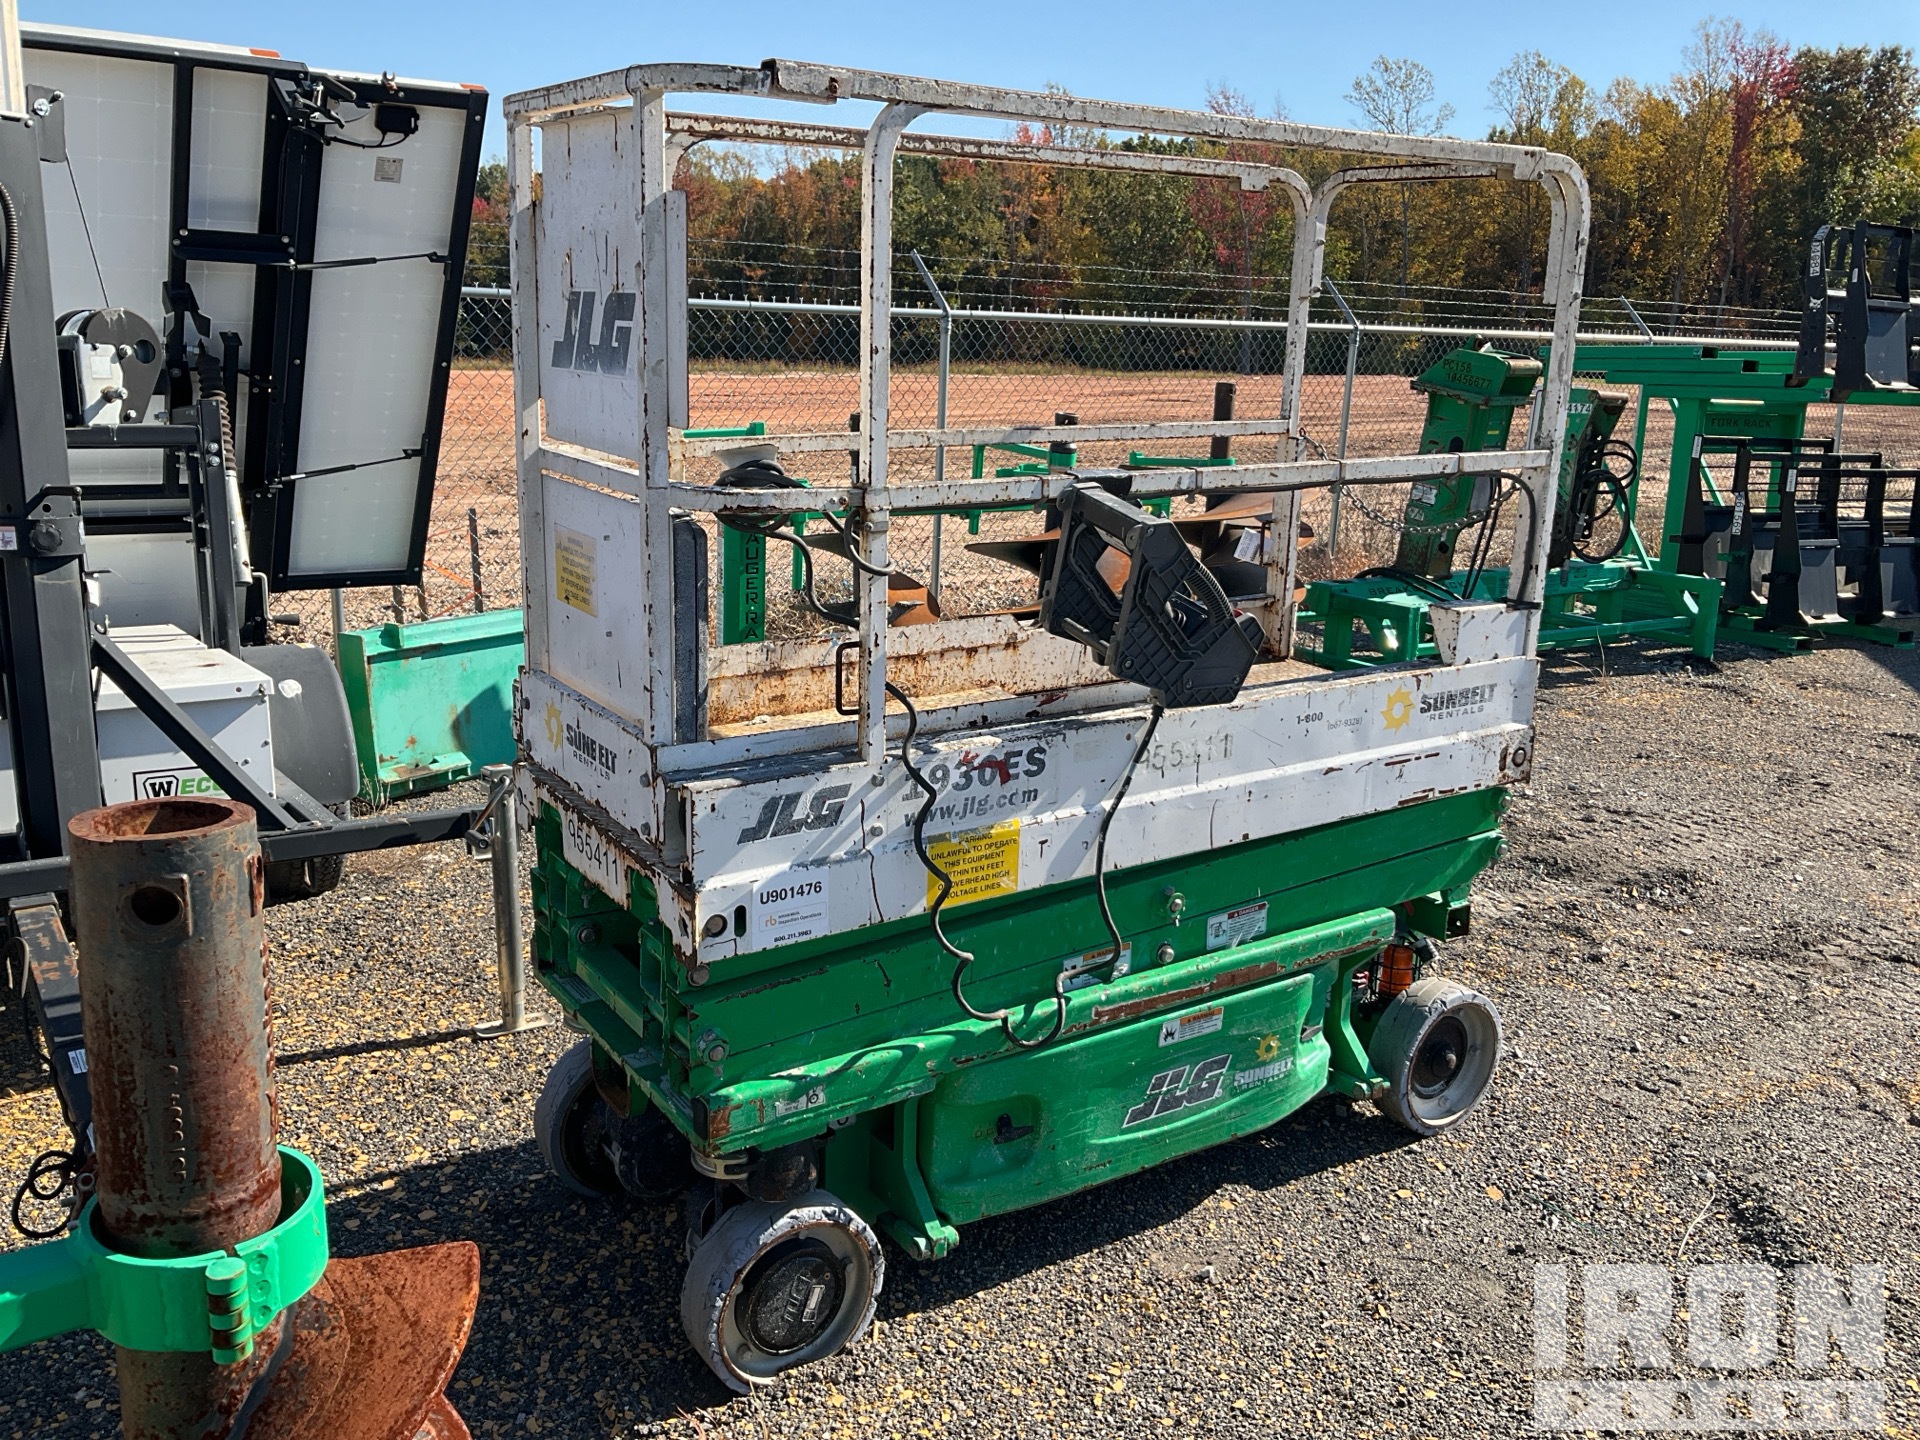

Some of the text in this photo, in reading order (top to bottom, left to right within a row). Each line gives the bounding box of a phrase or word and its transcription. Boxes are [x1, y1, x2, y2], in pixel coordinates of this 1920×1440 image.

[551, 290, 637, 377] JLG
[1442, 359, 1473, 373] PC158
[1711, 418, 1772, 429] FORK RACK
[745, 532, 761, 605] AUGER
[1368, 582, 1430, 597] BREAK
[1419, 682, 1498, 714] SUNBELT
[1429, 704, 1485, 722] RENTALS
[566, 722, 618, 775] SUNBELT
[901, 742, 1048, 802] 1930ES
[736, 782, 854, 846] JLG
[568, 818, 621, 886] 955411
[931, 837, 1018, 861] UNLAWFUL TO OPERATE
[944, 849, 1006, 869] THIS EQUIPMENT
[970, 864, 986, 874] TEN
[986, 860, 1005, 871] FEET
[950, 874, 991, 889] OVERHEAD
[991, 869, 1011, 879] HIGH
[980, 880, 1001, 892] LINES
[760, 881, 822, 904] U901476
[765, 915, 777, 927] rb
[1233, 1056, 1294, 1087] SUNBELT
[1121, 1053, 1233, 1129] JLG
